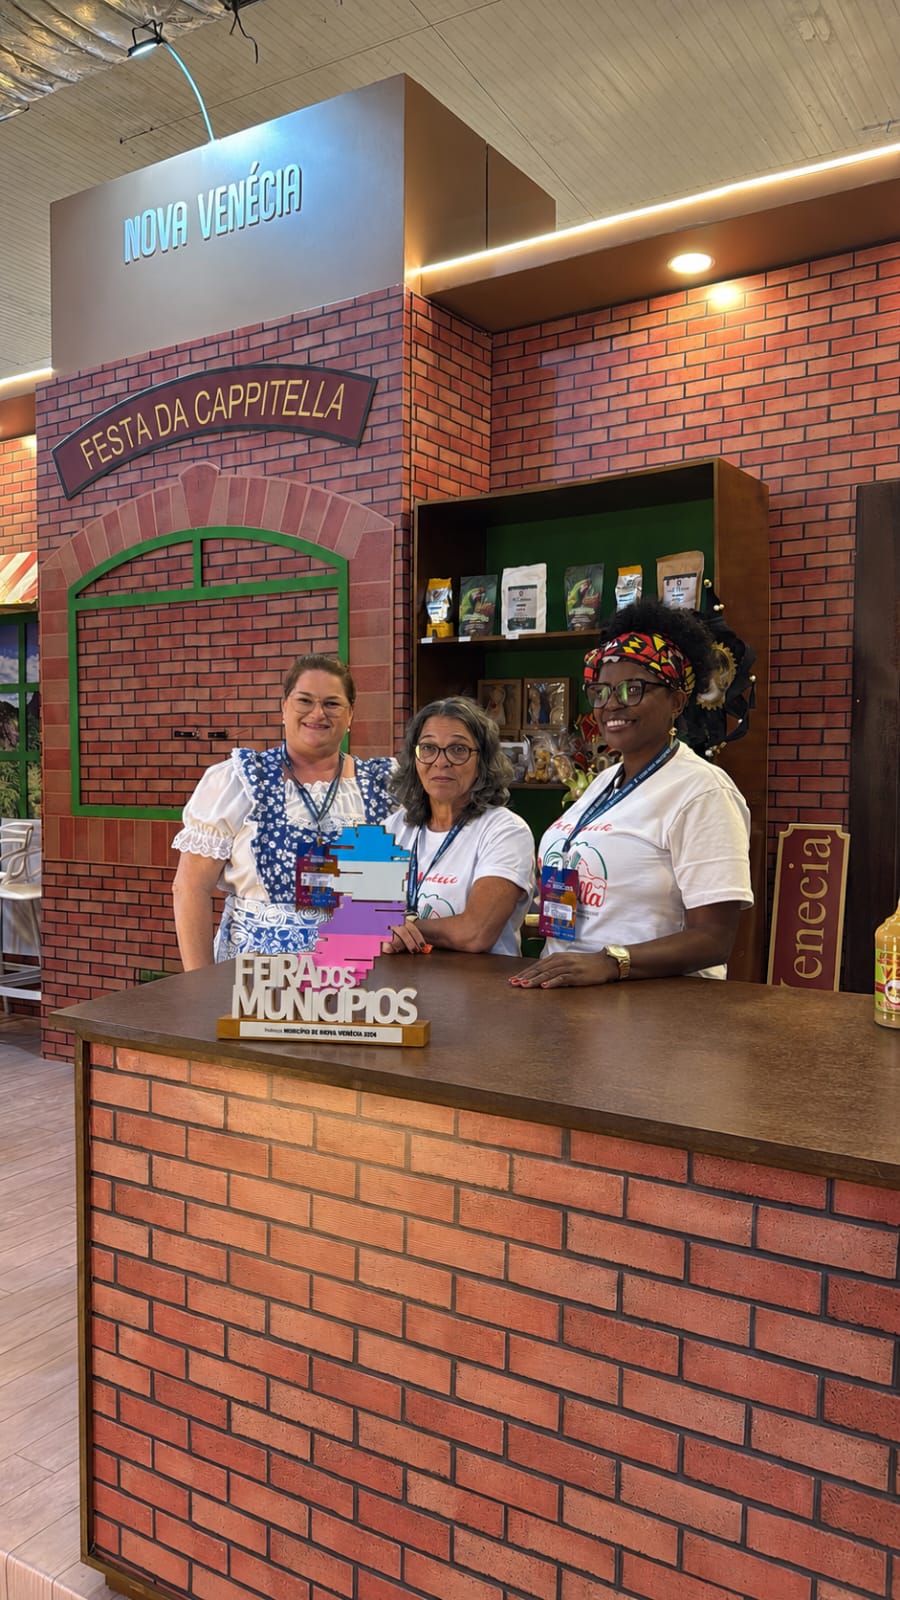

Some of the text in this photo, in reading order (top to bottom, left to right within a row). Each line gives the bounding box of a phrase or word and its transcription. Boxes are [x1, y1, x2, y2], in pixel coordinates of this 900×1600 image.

[124, 162, 302, 264] NOVA VENÉCIA
[80, 379, 345, 470] FESTA DA CAPPITELLA
[780, 834, 832, 988] enecia
[235, 952, 356, 989] FEIRA DOS
